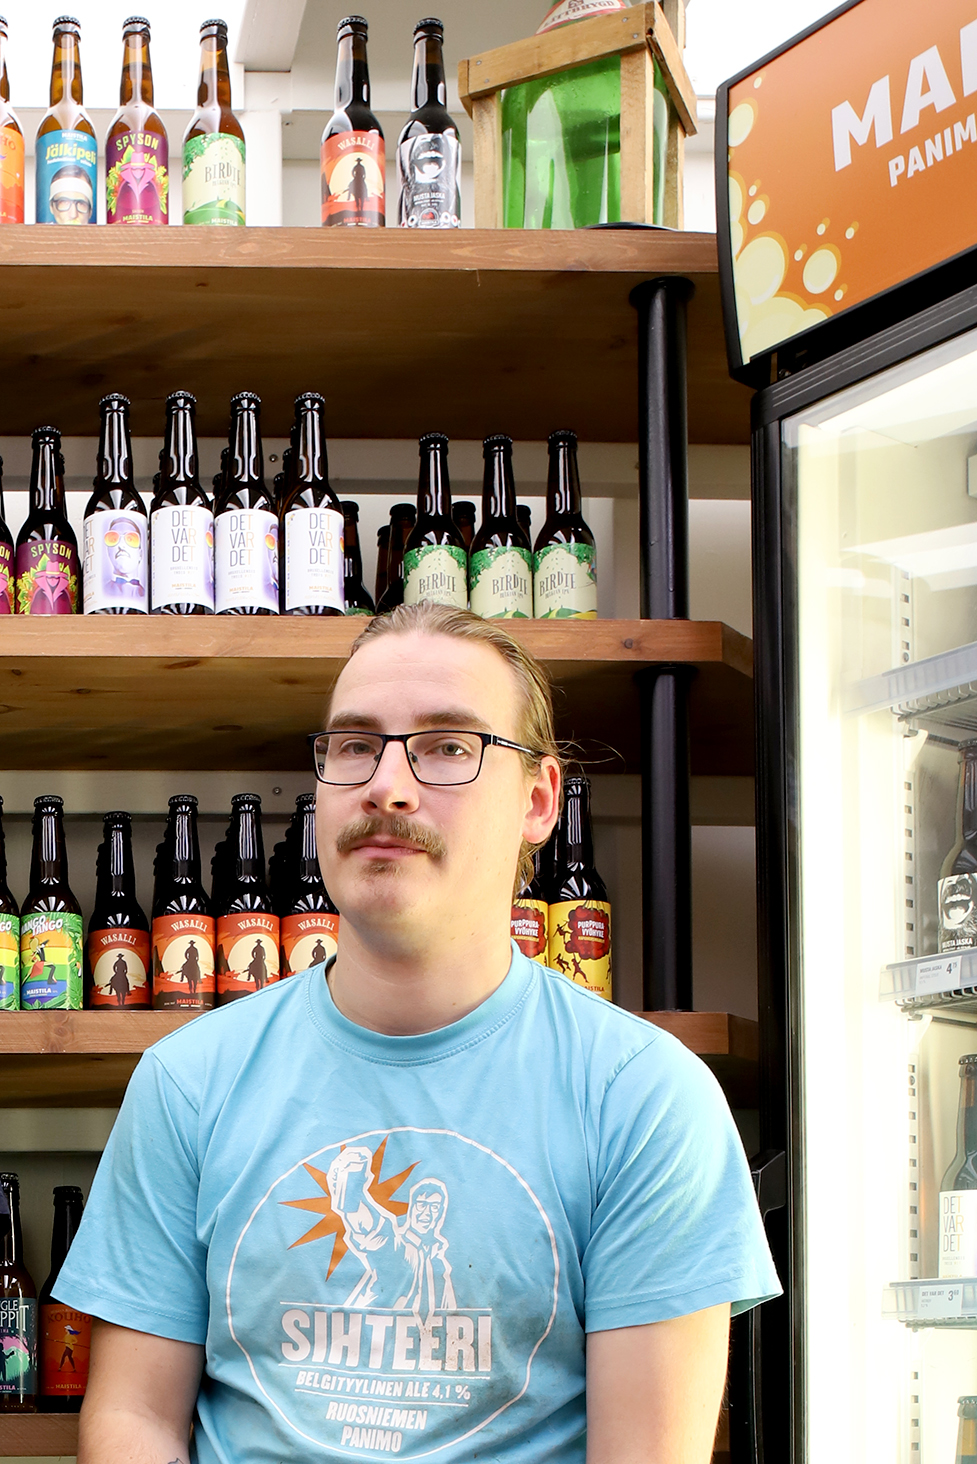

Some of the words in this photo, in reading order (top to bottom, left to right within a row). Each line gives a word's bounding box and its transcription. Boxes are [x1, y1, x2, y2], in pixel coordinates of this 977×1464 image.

[832, 19, 977, 172] MAI
[115, 133, 159, 151] SPYSON
[337, 136, 375, 151] WASALLI
[888, 113, 977, 187] PANIM
[45, 143, 97, 165] Jälkipeli
[205, 162, 241, 186] BIRDIE
[171, 510, 195, 528] DET
[230, 514, 253, 532] DET
[309, 513, 332, 530] DET
[171, 528, 197, 545] VAR
[229, 532, 254, 549] VAR
[309, 531, 333, 548] VAR
[31, 543, 72, 559] SPYSON
[171, 545, 195, 562] DET
[230, 549, 253, 567] DET
[309, 548, 331, 565] DET
[419, 572, 456, 594] BIRDIE
[492, 573, 527, 595] BIRDIE
[539, 571, 576, 597] BIRDIE
[32, 919, 63, 936] TANGO
[171, 919, 208, 933] WASALLI
[237, 918, 274, 932] WASALLI
[298, 917, 335, 931] WASALLI
[101, 933, 136, 946] WASALLI
[26, 987, 52, 995] MAISTILA
[943, 1195, 962, 1214] DET
[943, 1215, 964, 1233] VAR
[943, 1234, 962, 1252] DET
[47, 1312, 92, 1323] KOUHO
[281, 1310, 491, 1371] SIHTEERI
[296, 1371, 404, 1397] BELGITYYLINEN
[405, 1380, 431, 1398] ALE
[432, 1384, 453, 1400] 4,1
[455, 1384, 472, 1400] %
[325, 1401, 428, 1430] RUOSNIEMEN
[340, 1425, 403, 1452] PANIMO
